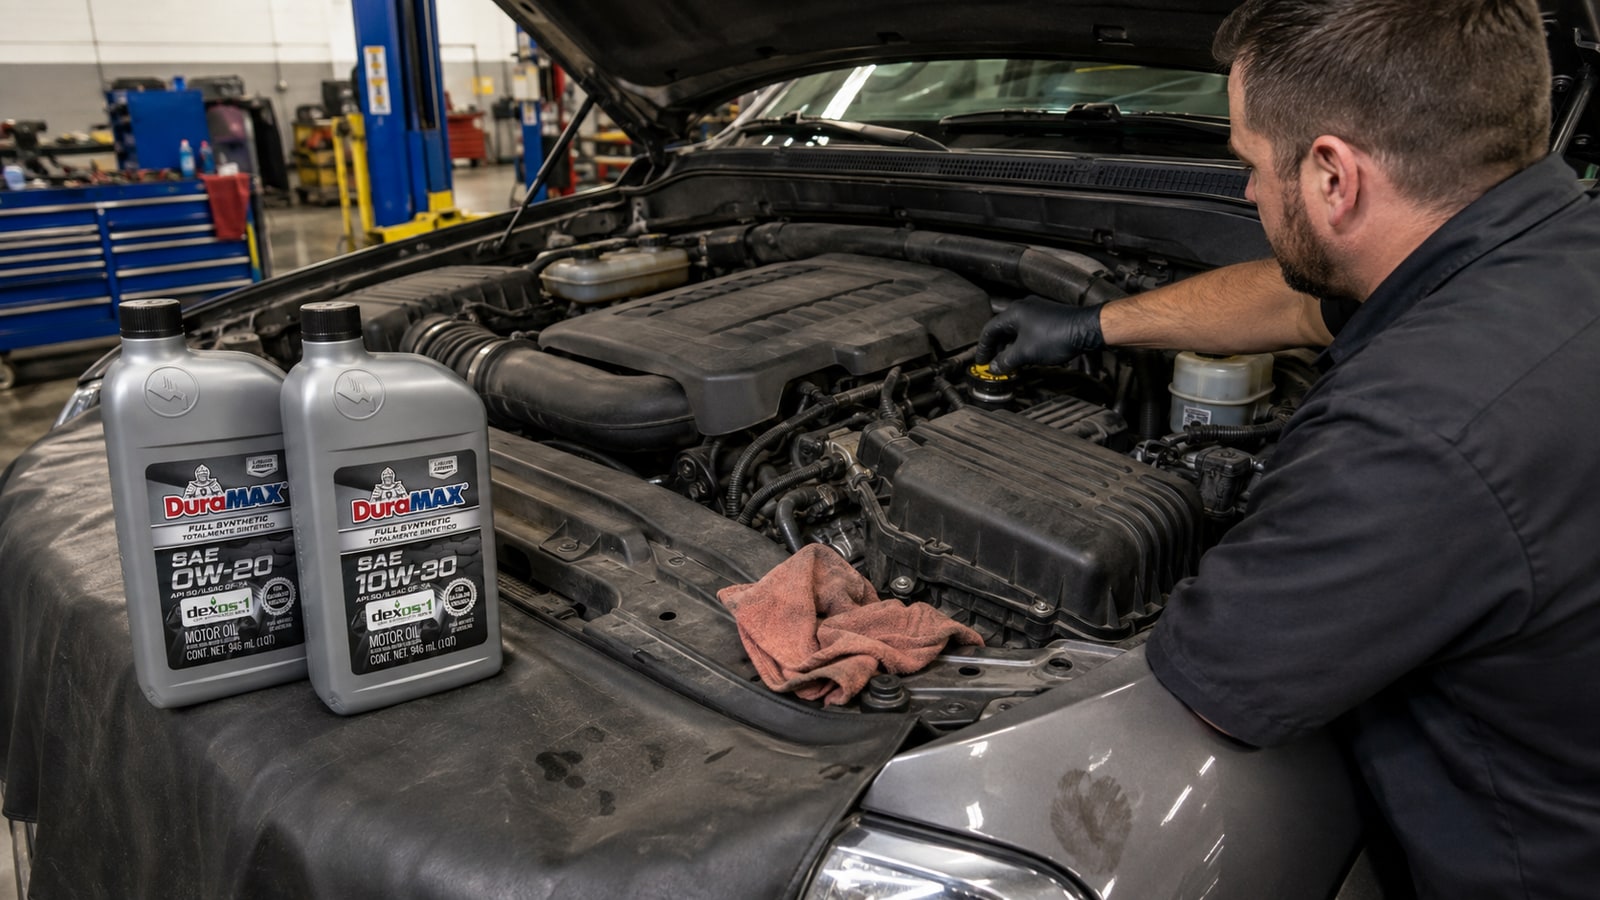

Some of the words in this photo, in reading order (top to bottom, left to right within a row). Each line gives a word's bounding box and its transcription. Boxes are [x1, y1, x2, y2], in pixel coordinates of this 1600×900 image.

[164, 484, 285, 518] DuraMAX
[352, 484, 466, 523] DuraMAX
[189, 524, 213, 532] FULL
[217, 515, 268, 529] SYNTHETIC
[375, 526, 398, 536] FULL
[401, 517, 451, 532] SYNTHETIC
[183, 529, 235, 540] TOTALMENTE
[368, 531, 418, 544] TOTALMENTE
[172, 547, 220, 567] SAE
[358, 550, 403, 572] SAE
[171, 555, 273, 590] 0W-20
[355, 555, 457, 595] 10W-30
[185, 626, 220, 644] MOTOR
[223, 623, 238, 637] OIL
[369, 629, 404, 648] MOTOR
[405, 625, 420, 640] OIL
[186, 648, 209, 660] CONT.
[211, 645, 226, 656] NET.
[228, 641, 242, 653] 946
[244, 639, 255, 649] mL
[370, 652, 391, 665] CONT.
[393, 648, 408, 660] NET.
[410, 643, 424, 656] 946
[425, 641, 437, 652] mL
